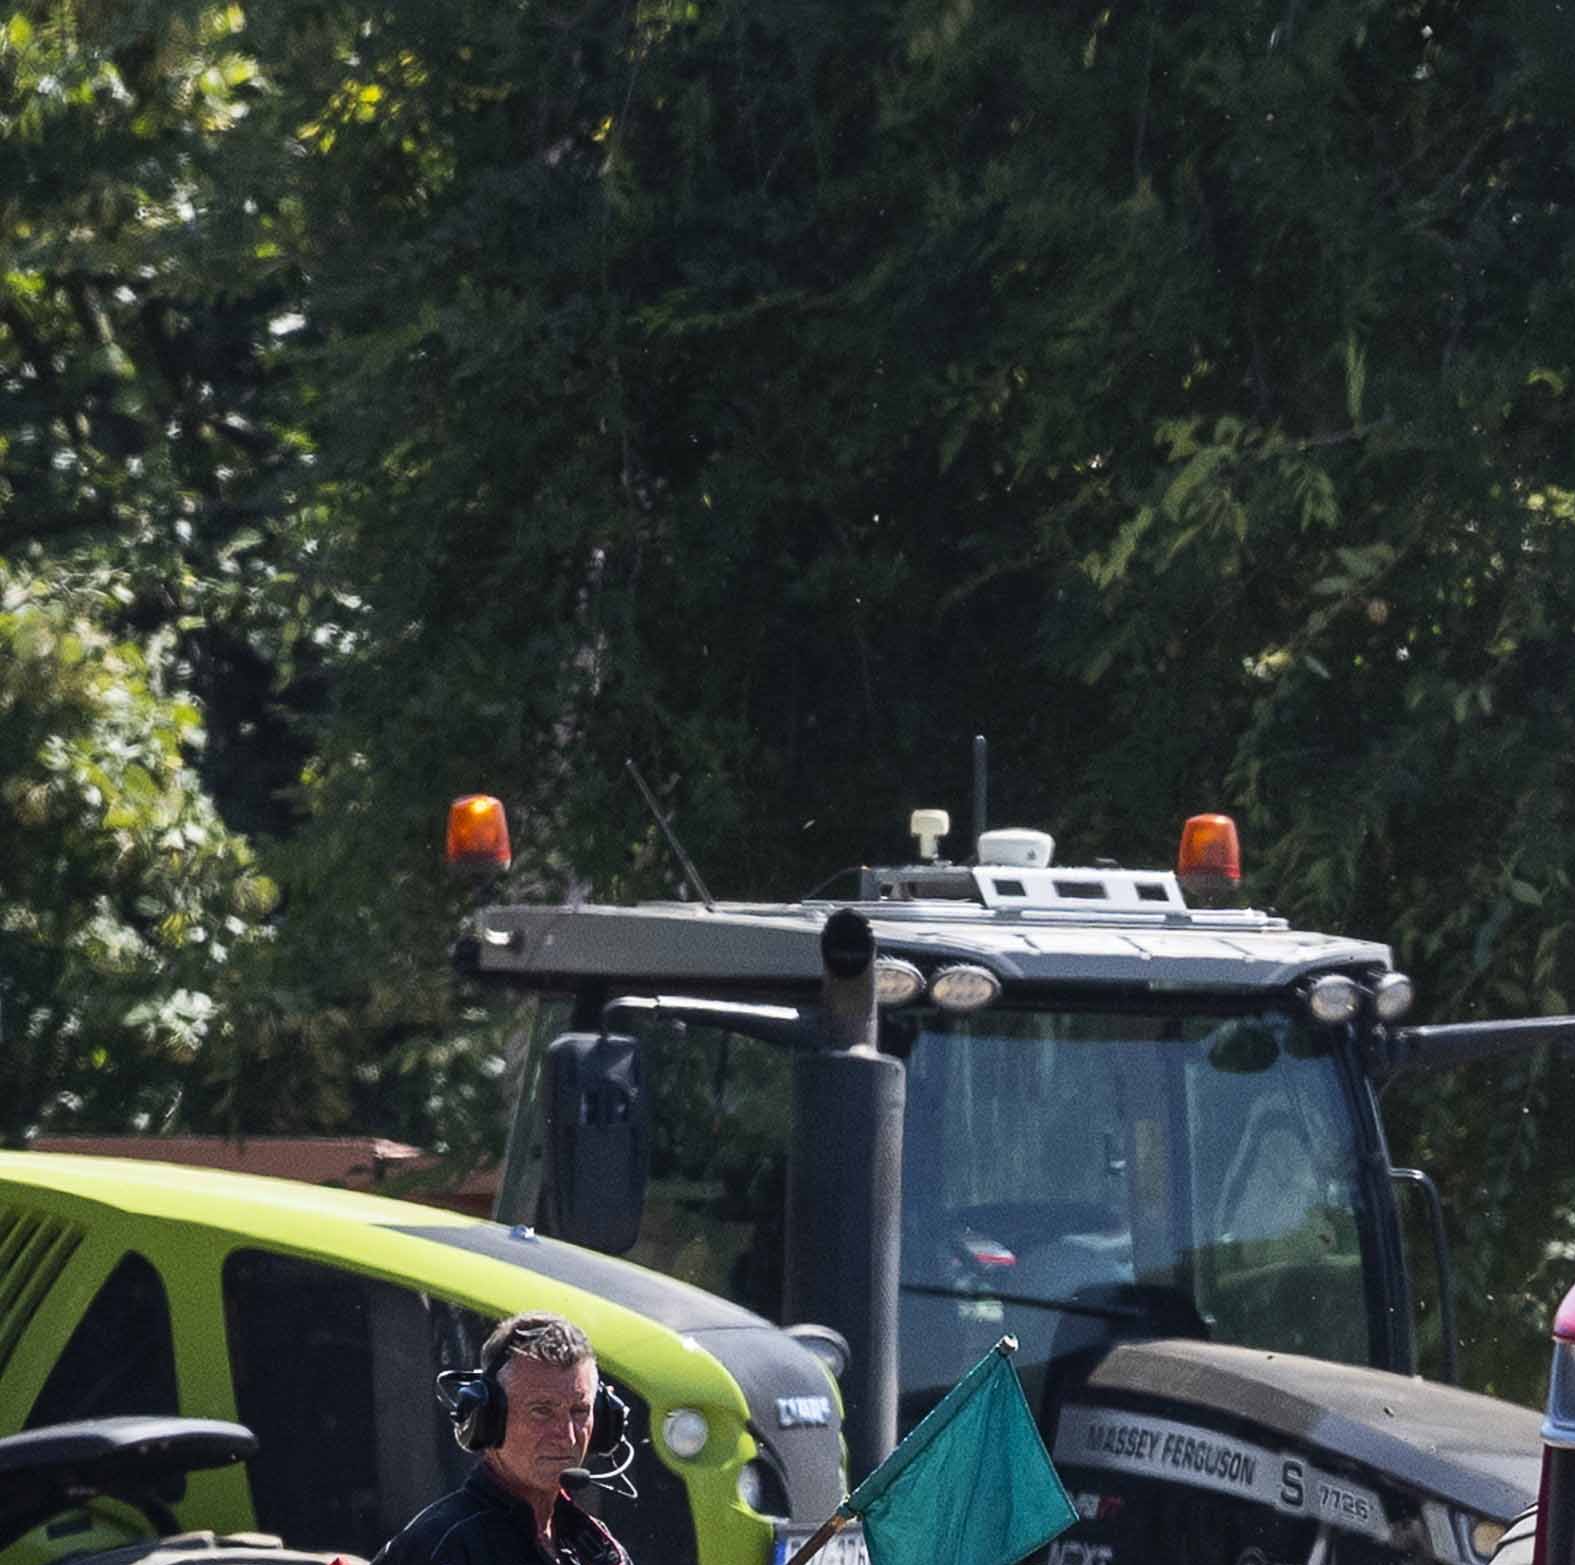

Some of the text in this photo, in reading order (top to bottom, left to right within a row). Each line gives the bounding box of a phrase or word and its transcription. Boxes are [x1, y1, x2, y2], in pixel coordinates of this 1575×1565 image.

[1087, 1423, 1370, 1523] MASSEY FERGUSON S 7726
